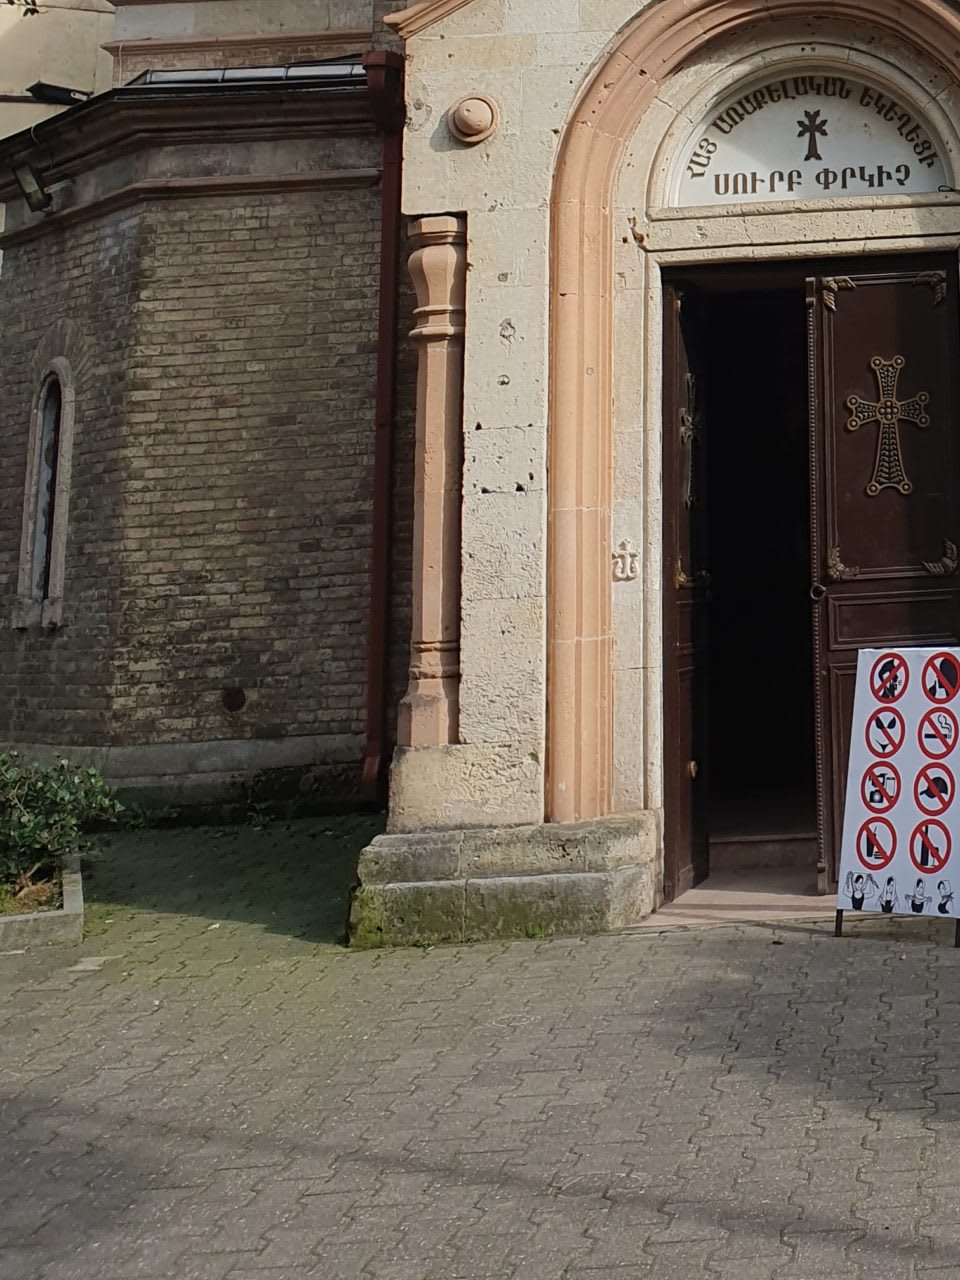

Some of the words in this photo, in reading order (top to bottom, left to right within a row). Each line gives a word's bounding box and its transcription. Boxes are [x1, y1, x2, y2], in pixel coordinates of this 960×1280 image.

[859, 86, 939, 169] ԵԿԵՂԵՑԻ
[713, 169, 803, 195] ՍՈՒՐԲ
[815, 163, 911, 190] ՓՐԿԻՉ
